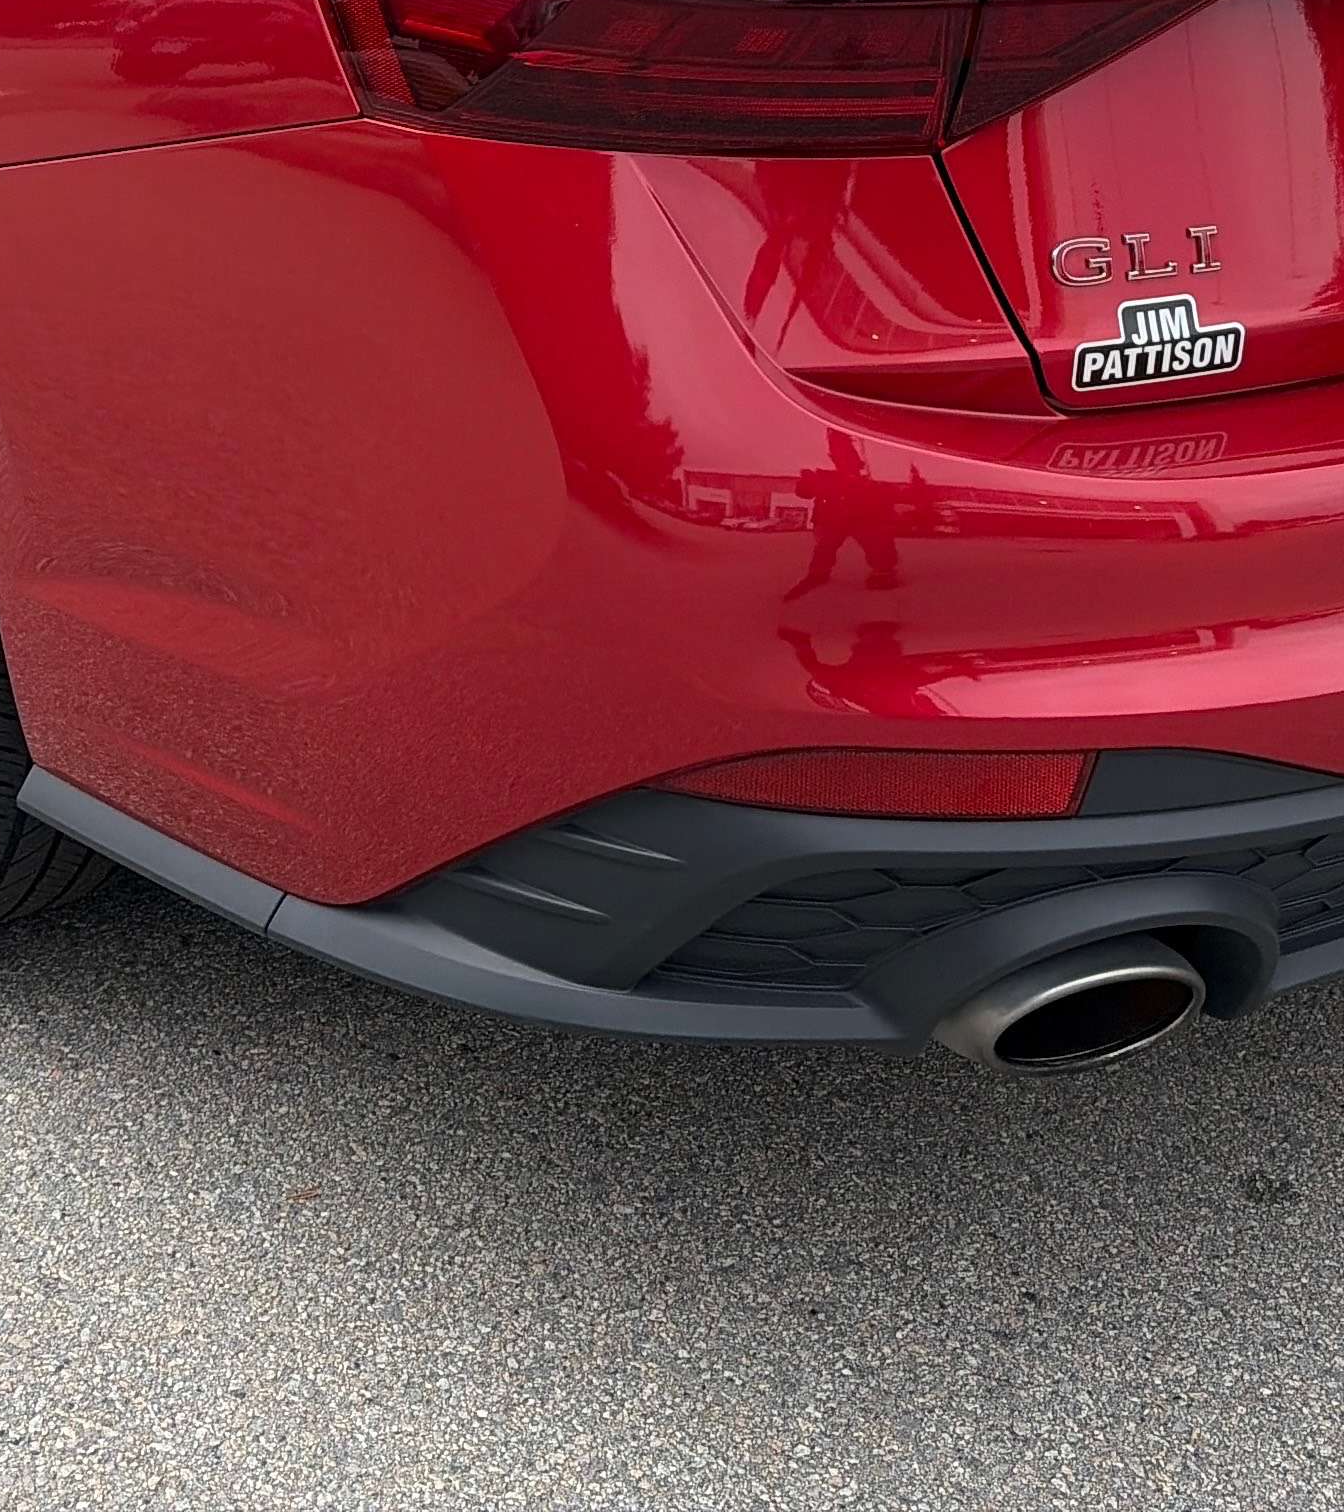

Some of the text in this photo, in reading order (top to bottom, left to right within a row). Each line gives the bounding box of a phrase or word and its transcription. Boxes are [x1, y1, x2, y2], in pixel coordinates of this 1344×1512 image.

[1051, 225, 1223, 287] GLI
[1131, 305, 1191, 346] JIM
[1082, 333, 1235, 383] PATTISON
